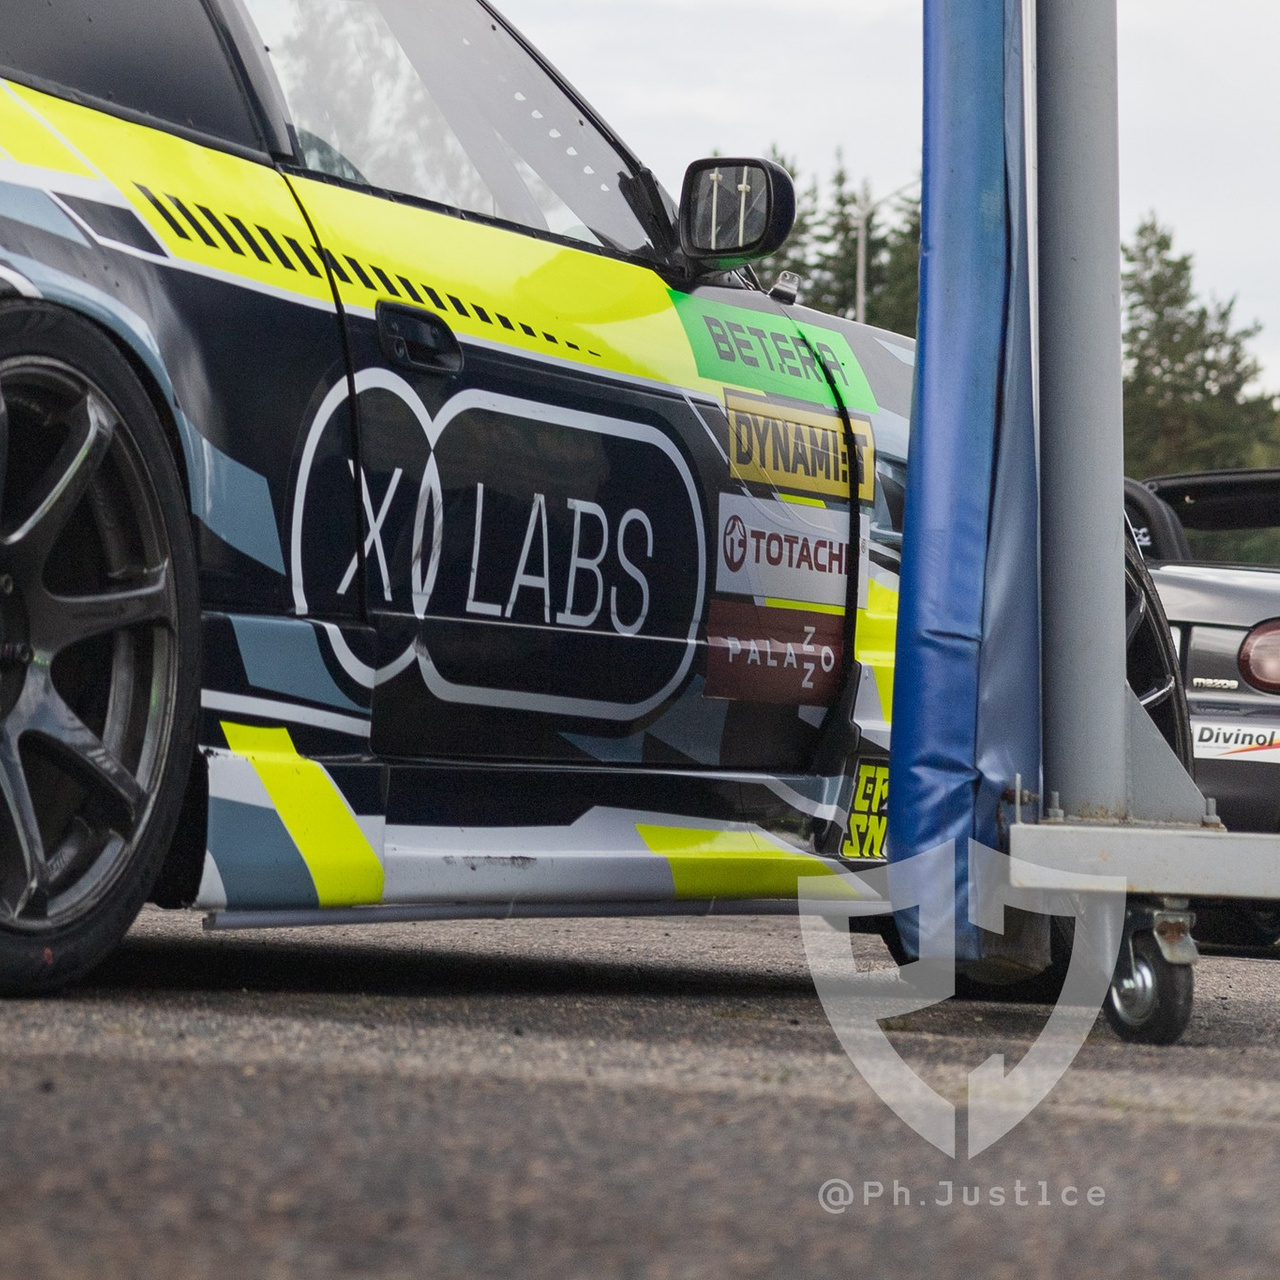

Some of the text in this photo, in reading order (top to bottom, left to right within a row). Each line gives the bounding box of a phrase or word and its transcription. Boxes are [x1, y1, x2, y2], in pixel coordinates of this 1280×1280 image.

[702, 314, 849, 386] BETERA
[466, 482, 654, 637] LABS
[1197, 726, 1275, 747] Divinol
